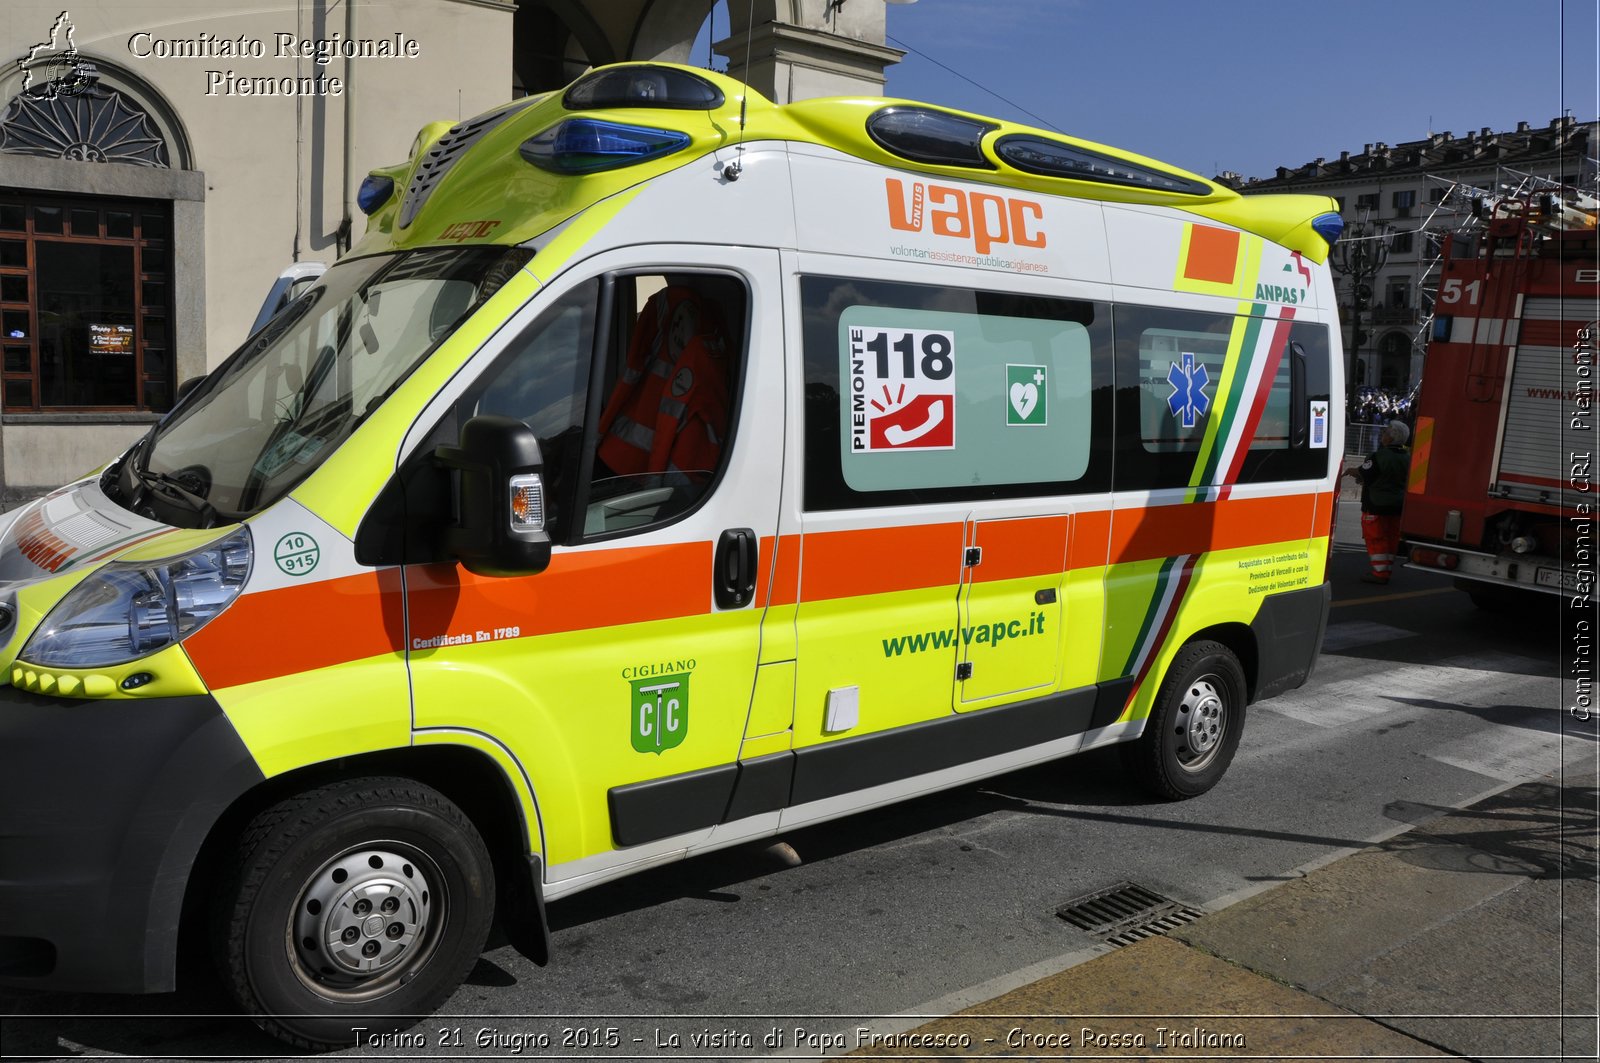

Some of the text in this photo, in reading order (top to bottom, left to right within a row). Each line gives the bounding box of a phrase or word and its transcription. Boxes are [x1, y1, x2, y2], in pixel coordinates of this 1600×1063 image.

[885, 178, 1047, 255] vapc
[913, 185, 923, 228] ONLUS
[1255, 283, 1298, 304] ANPAS
[1441, 278, 1480, 305] 51
[867, 332, 953, 380] 118
[851, 329, 866, 450] PIEMONTE
[284, 536, 304, 551] 10
[285, 555, 315, 571] 915
[1276, 553, 1297, 563] contributo
[1249, 571, 1270, 580] Provincia
[1271, 569, 1275, 577] di
[1276, 566, 1292, 575] Vercelli
[1540, 571, 1552, 582] VF
[1248, 584, 1268, 594] Dedizione
[1277, 580, 1295, 589] Volontari
[1296, 577, 1308, 585] VAPC
[413, 626, 520, 649] Certificata En 1789
[882, 611, 1045, 658] www.vapc.it
[622, 659, 697, 679] CIGLIANO
